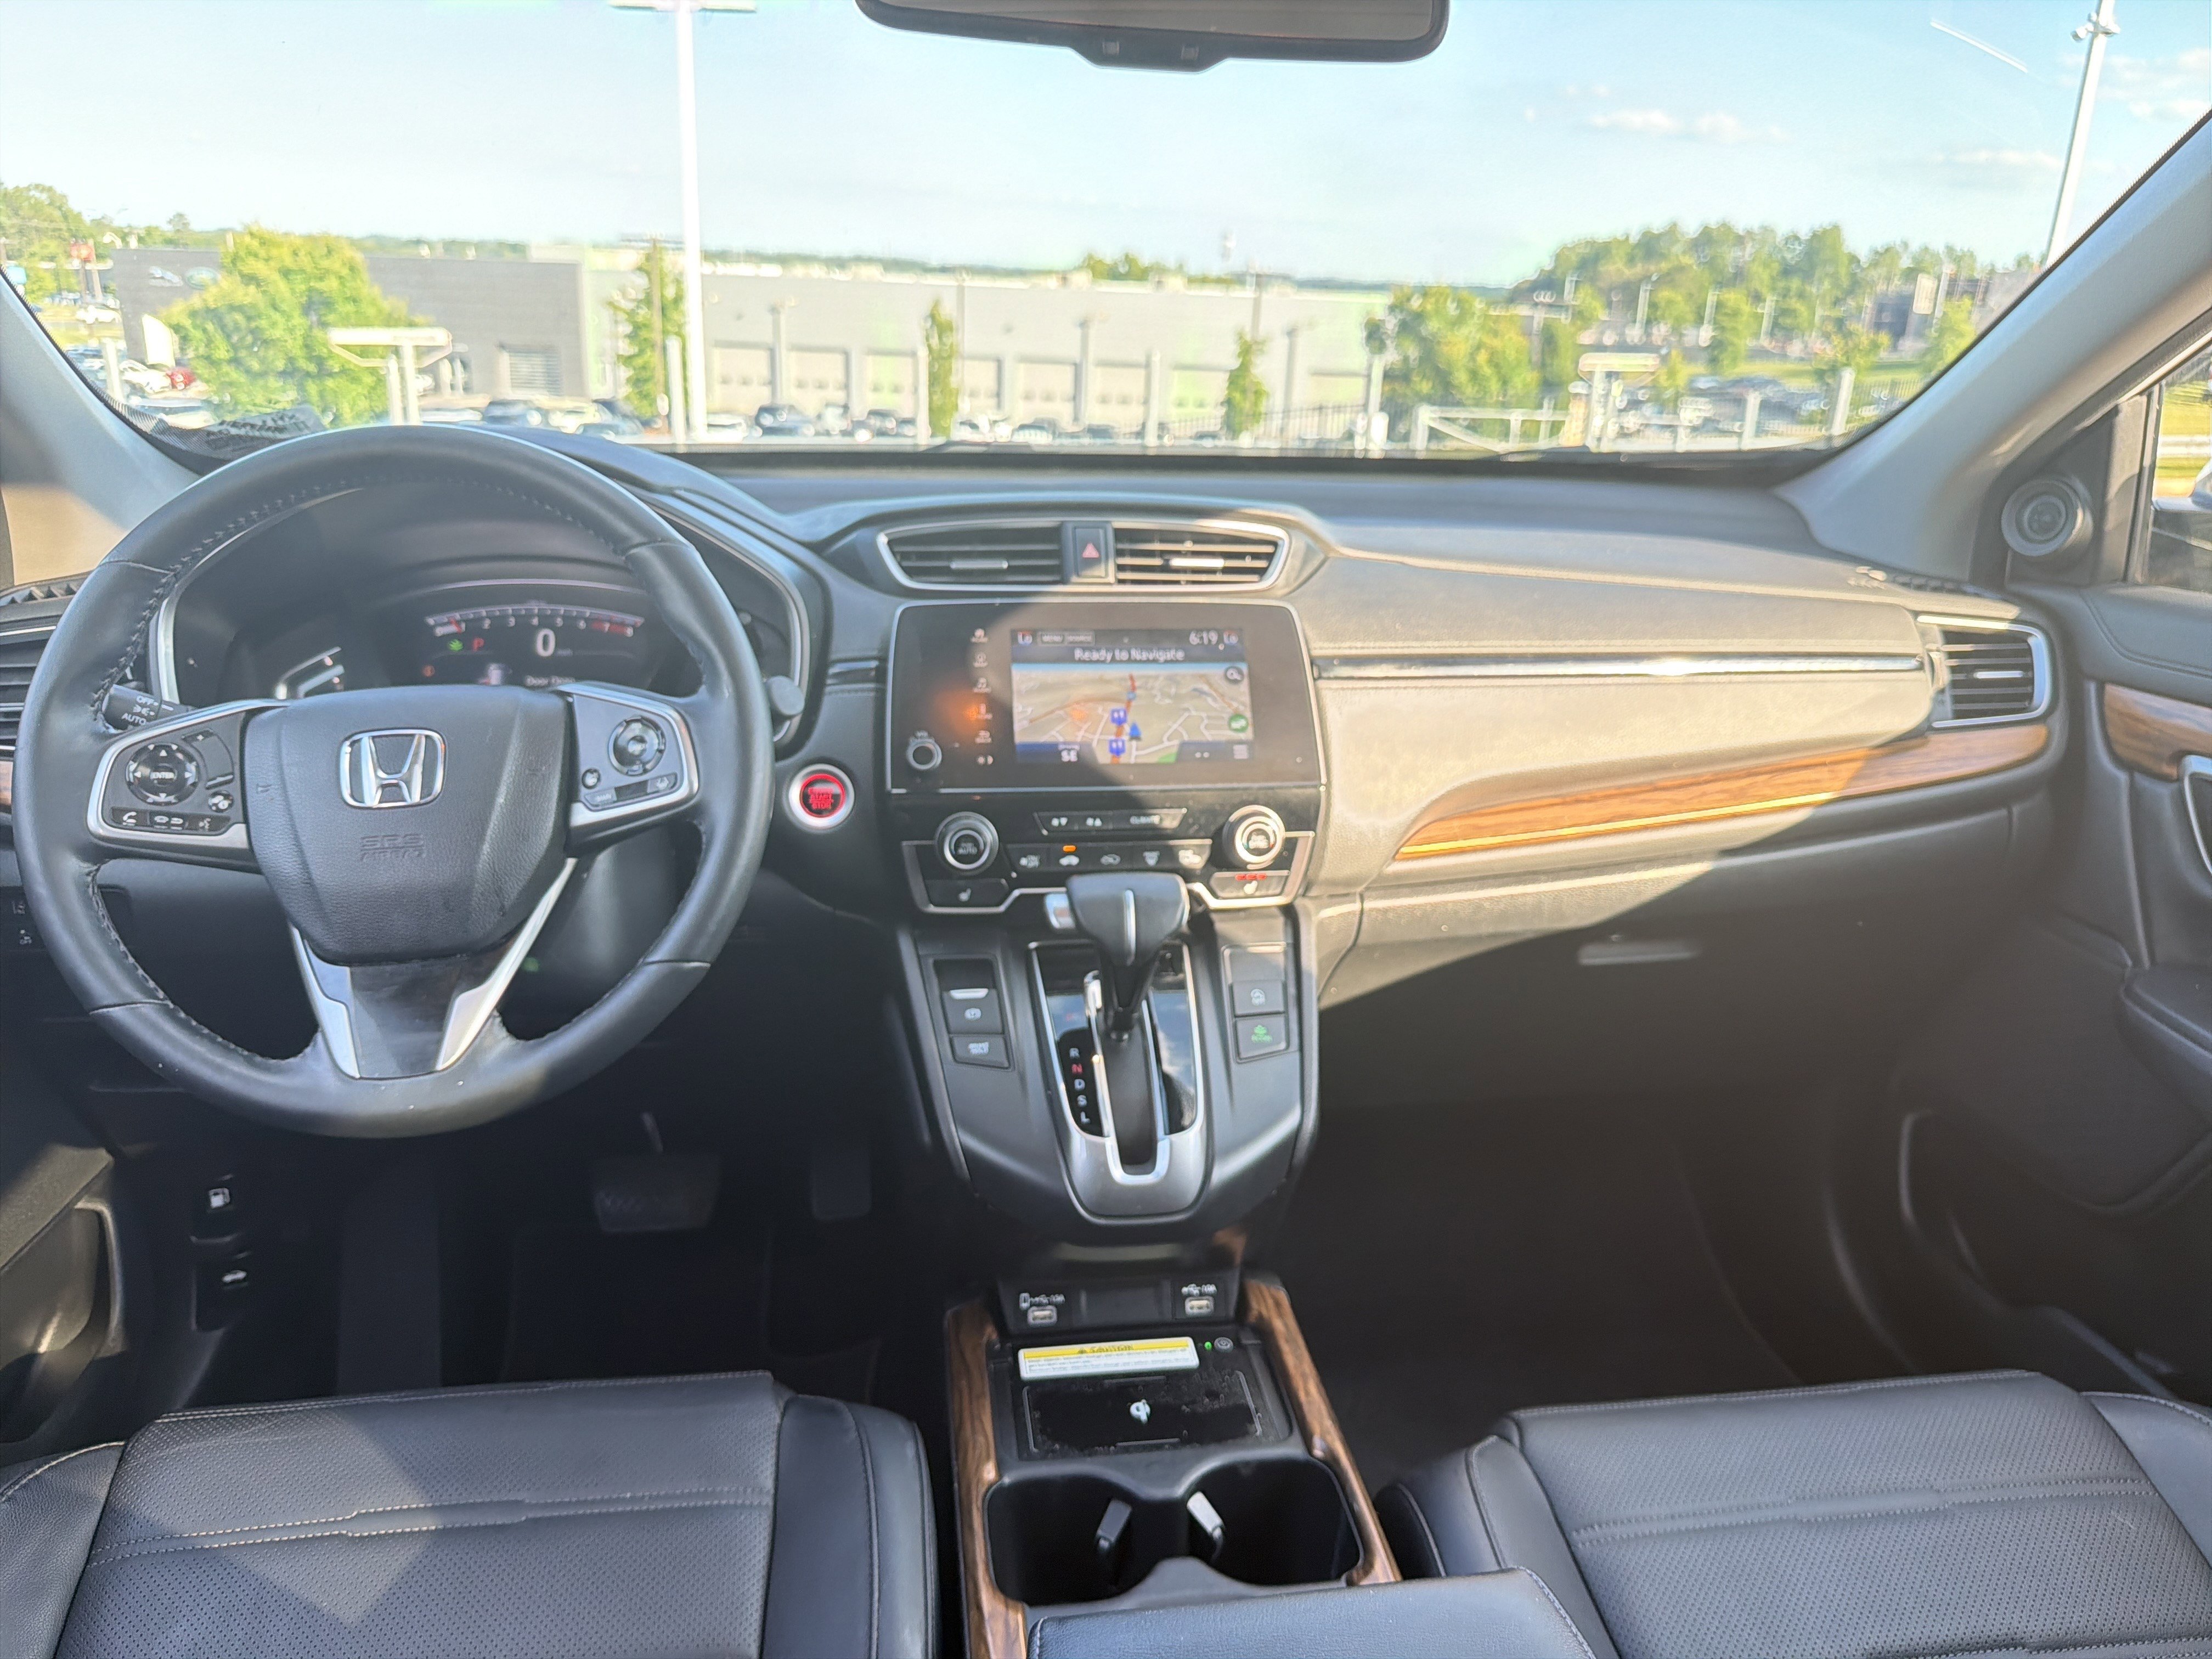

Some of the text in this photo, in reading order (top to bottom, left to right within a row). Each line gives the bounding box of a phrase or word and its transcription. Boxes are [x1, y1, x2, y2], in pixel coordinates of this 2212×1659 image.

[537, 628, 555, 656] 0
[1189, 629, 1218, 645] 6:19
[473, 637, 485, 651] P
[1074, 647, 1185, 663] Ready to Navigate
[121, 713, 147, 726] AUTO
[1069, 1047, 1080, 1059] R
[1071, 1063, 1083, 1074] N
[1074, 1079, 1085, 1091] D
[1077, 1094, 1087, 1107] S
[1080, 1111, 1091, 1124] L
